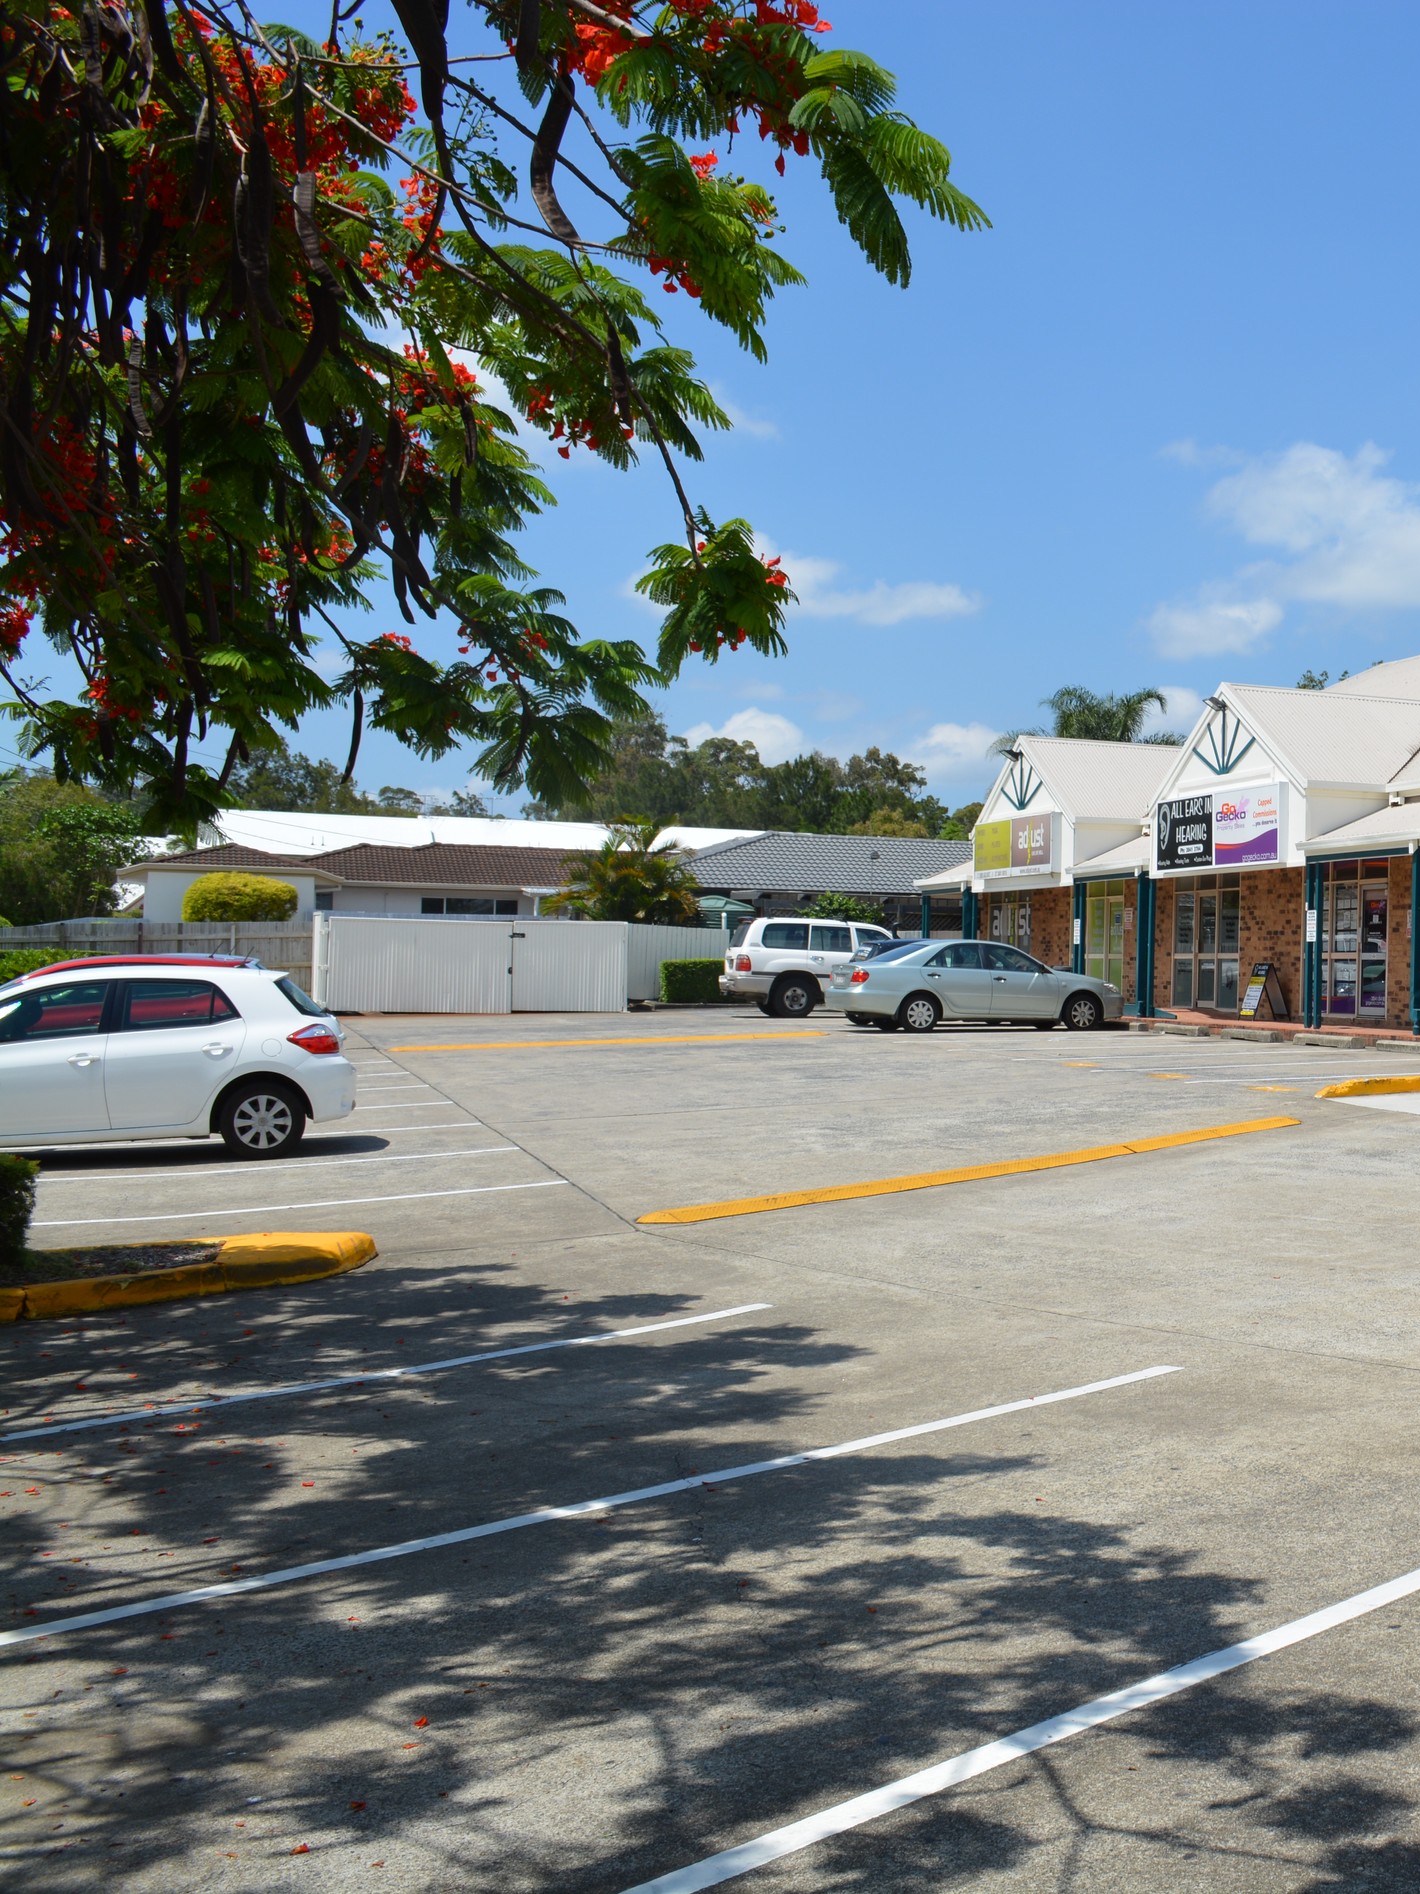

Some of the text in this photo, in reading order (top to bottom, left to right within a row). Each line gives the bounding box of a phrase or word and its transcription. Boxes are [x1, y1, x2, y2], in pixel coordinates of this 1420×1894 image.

[1171, 796, 1213, 819] ALL EARS IN
[1252, 809, 1277, 819] Commissions
[1175, 823, 1207, 843] HEARING
